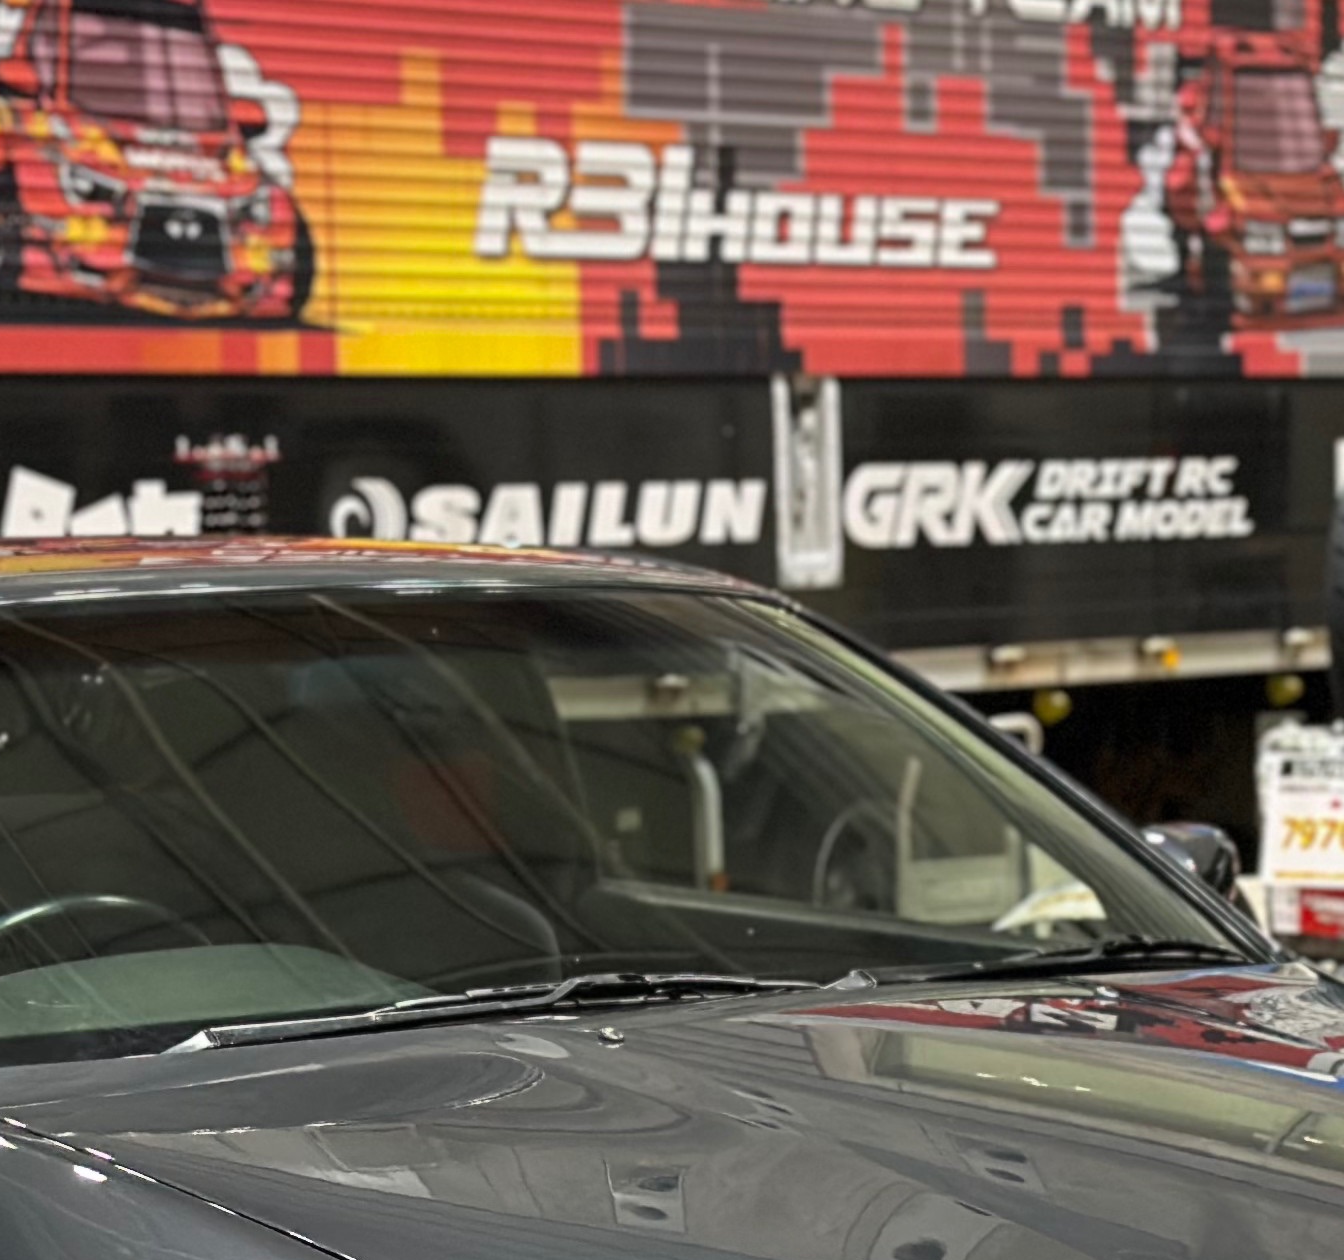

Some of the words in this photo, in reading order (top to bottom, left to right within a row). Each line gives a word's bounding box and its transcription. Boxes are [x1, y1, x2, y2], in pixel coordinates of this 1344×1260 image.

[843, 460, 1035, 550] GRK
[1034, 457, 1176, 500] DRIFT
[1173, 455, 1239, 498] RC
[409, 478, 767, 547] SAILUN
[1019, 504, 1111, 543] CAR
[1113, 497, 1255, 541] MODEL
